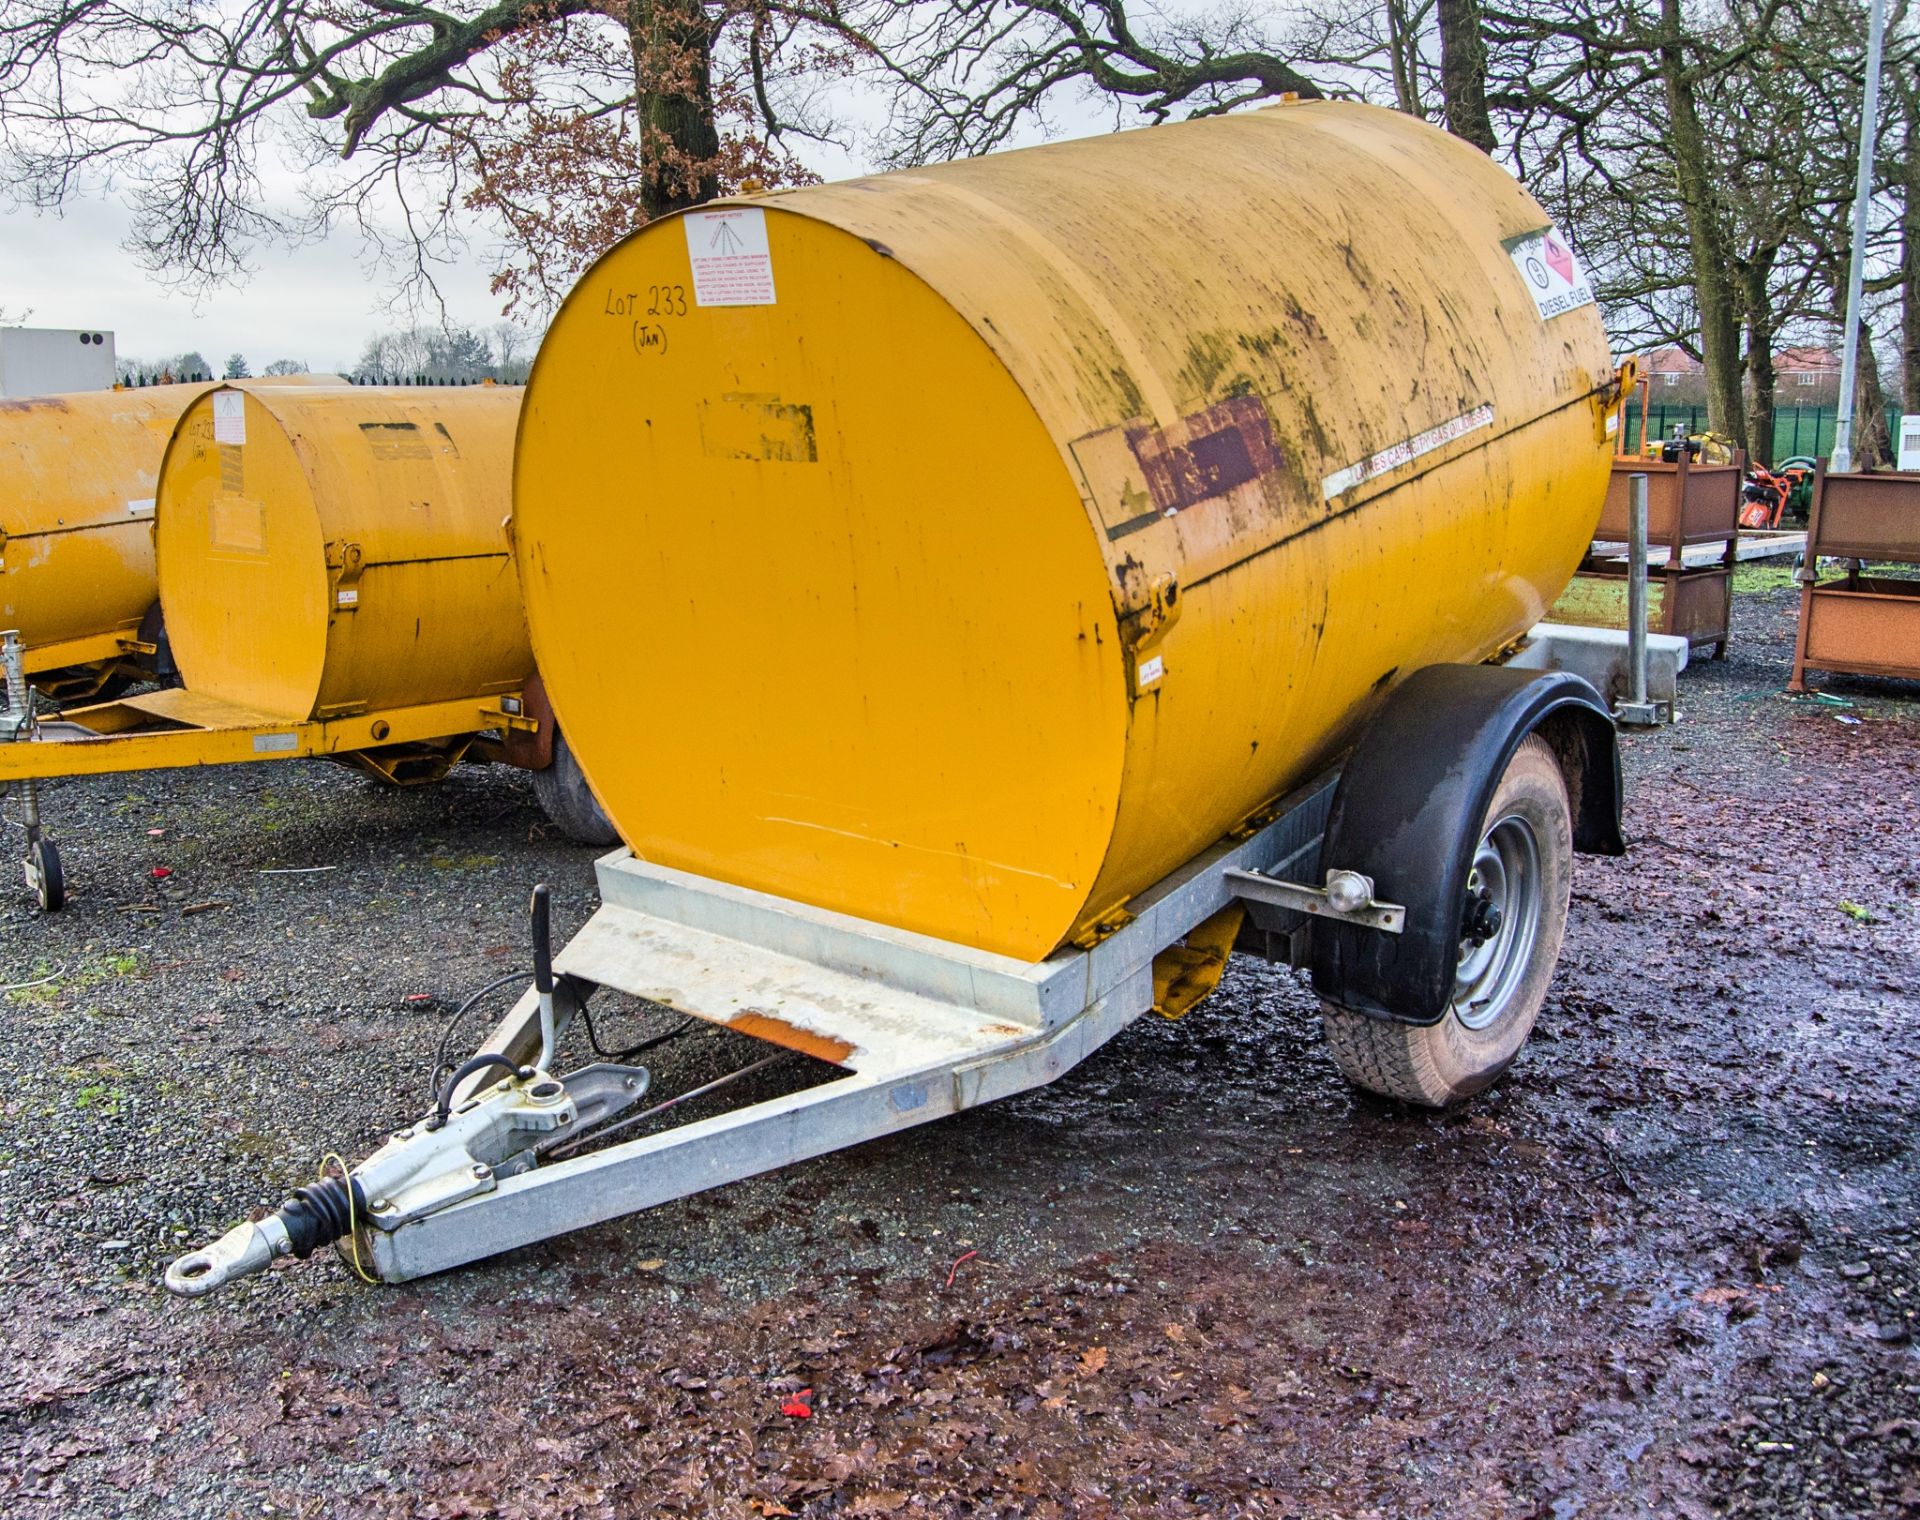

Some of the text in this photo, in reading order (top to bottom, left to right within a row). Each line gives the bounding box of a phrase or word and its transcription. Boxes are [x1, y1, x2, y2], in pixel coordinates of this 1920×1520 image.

[605, 285, 687, 317] LOT 233
[1539, 286, 1592, 317] DIESEL FUEL
[1387, 433, 1431, 465] CAPACITY
[1431, 427, 1449, 445] GAS
